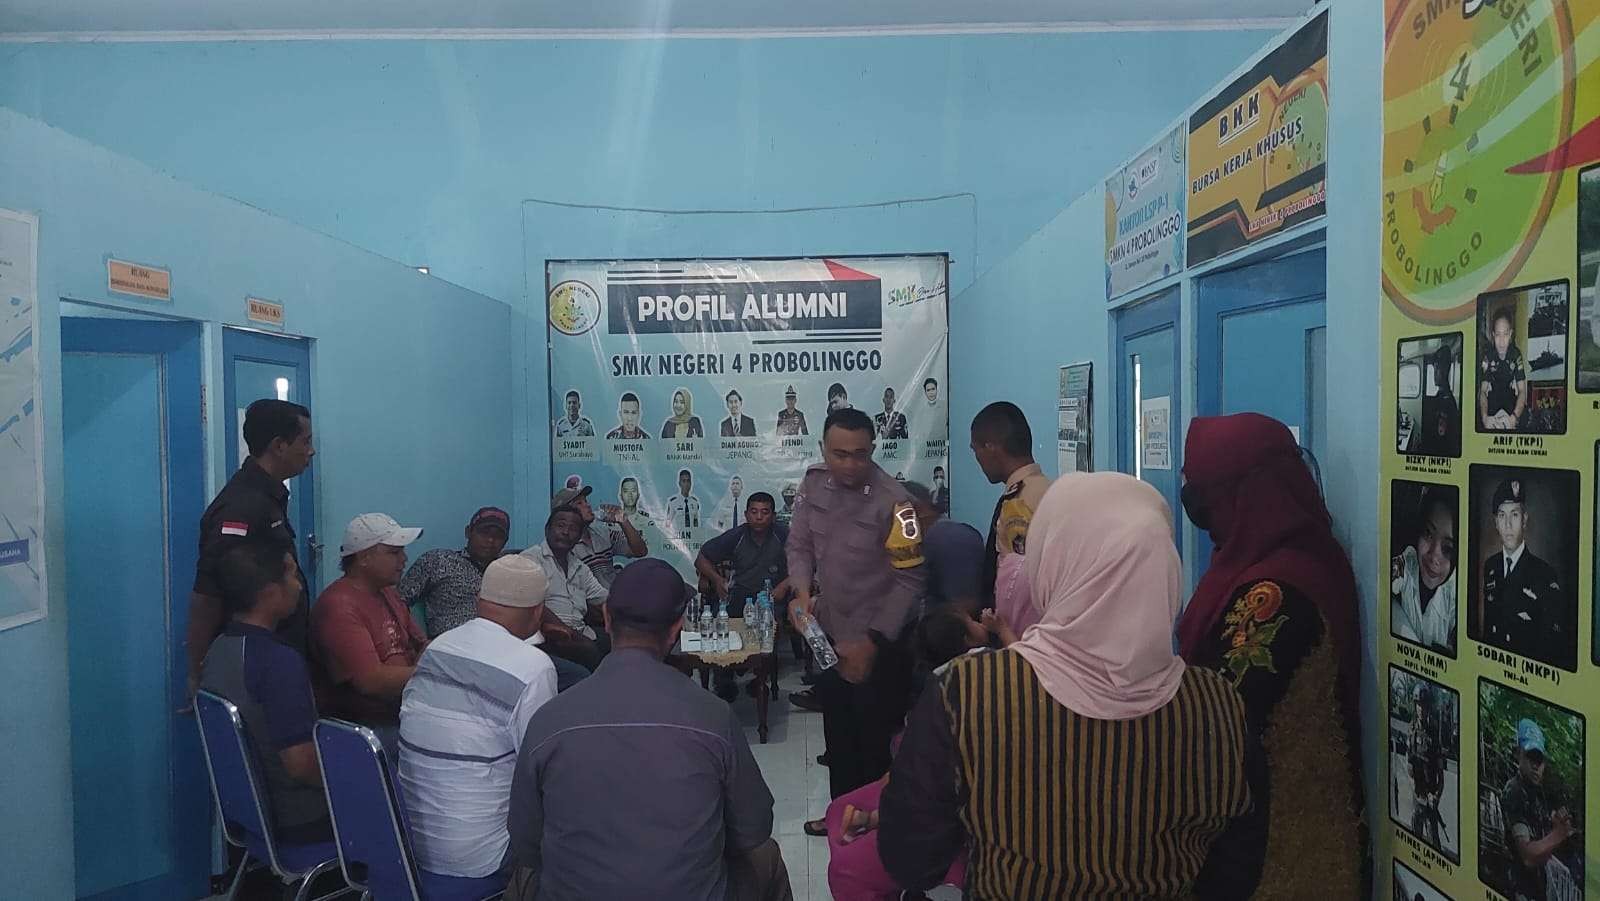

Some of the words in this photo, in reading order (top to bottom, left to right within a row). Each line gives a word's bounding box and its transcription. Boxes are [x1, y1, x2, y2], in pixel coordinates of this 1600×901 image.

[1449, 51, 1472, 101] 4
[1192, 168, 1220, 194] BURSA
[1224, 148, 1252, 177] KERJA
[1256, 116, 1301, 157] KHUSUS
[1130, 213, 1180, 255] PROBOLINGGO
[1386, 190, 1482, 286] PROBOLINGGO
[638, 294, 736, 322] PROFIL
[741, 292, 848, 320] ALUMNI
[612, 354, 652, 377] SMK
[658, 353, 724, 375] NEGERI
[732, 355, 742, 374] 4
[750, 349, 882, 373] PROBOLINGGO
[563, 441, 585, 450] SYADIT
[613, 443, 644, 452] MUSTOFA
[676, 442, 694, 451] SARI
[721, 441, 736, 450] DIAN
[882, 442, 898, 450] JAGO
[1493, 436, 1513, 446] ARIF
[1516, 436, 1543, 448] (TKPI)
[727, 451, 753, 460] JEPANG
[1406, 456, 1426, 465] RIZKY
[1397, 643, 1420, 661] NOVA
[1423, 653, 1448, 673] (MM)
[1477, 645, 1517, 668] SOBARI
[1521, 659, 1560, 686] (NKPI)
[1404, 659, 1418, 670] SIPIL
[1420, 666, 1438, 678] POLRI
[1503, 670, 1528, 685] TNI-AL
[1395, 829, 1421, 851] AFINES
